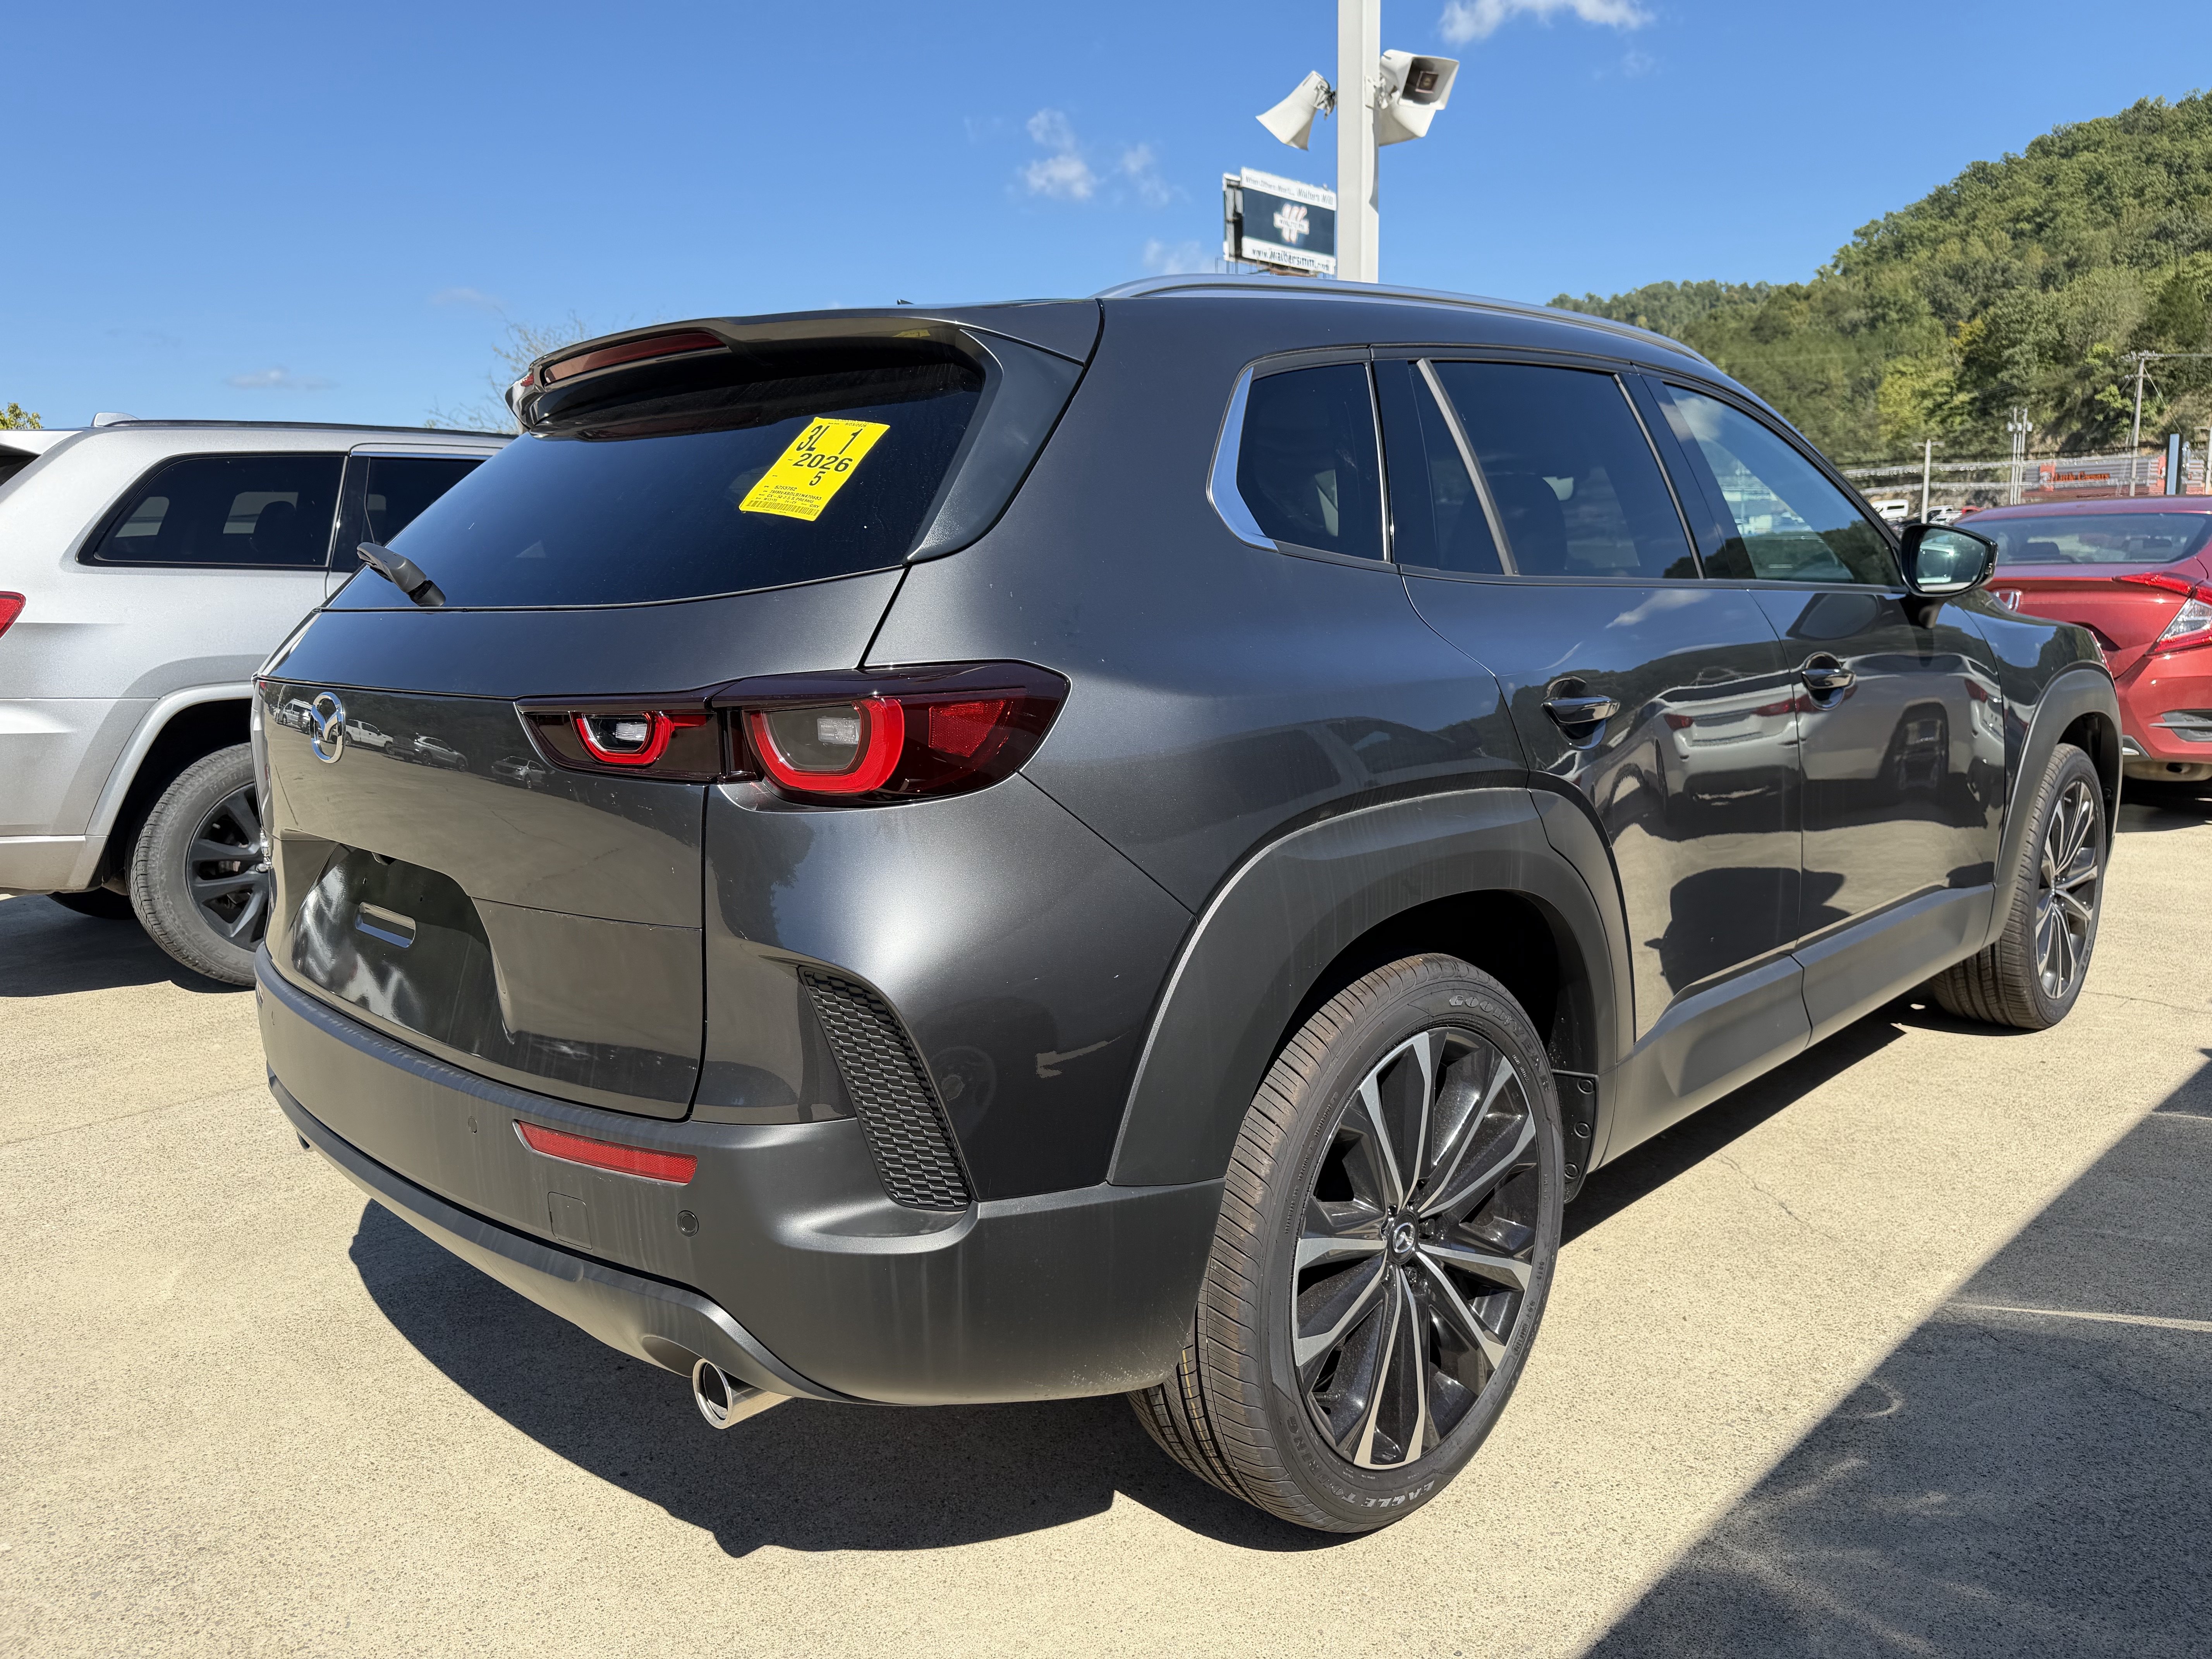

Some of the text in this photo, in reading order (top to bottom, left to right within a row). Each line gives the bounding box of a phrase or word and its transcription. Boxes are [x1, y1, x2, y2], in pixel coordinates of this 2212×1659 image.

[838, 428, 864, 454] 1
[792, 453, 853, 472] 2026
[809, 471, 826, 486] 5
[1287, 1415, 1356, 1504] TOURING
[1361, 1480, 1434, 1508] EAGLE
